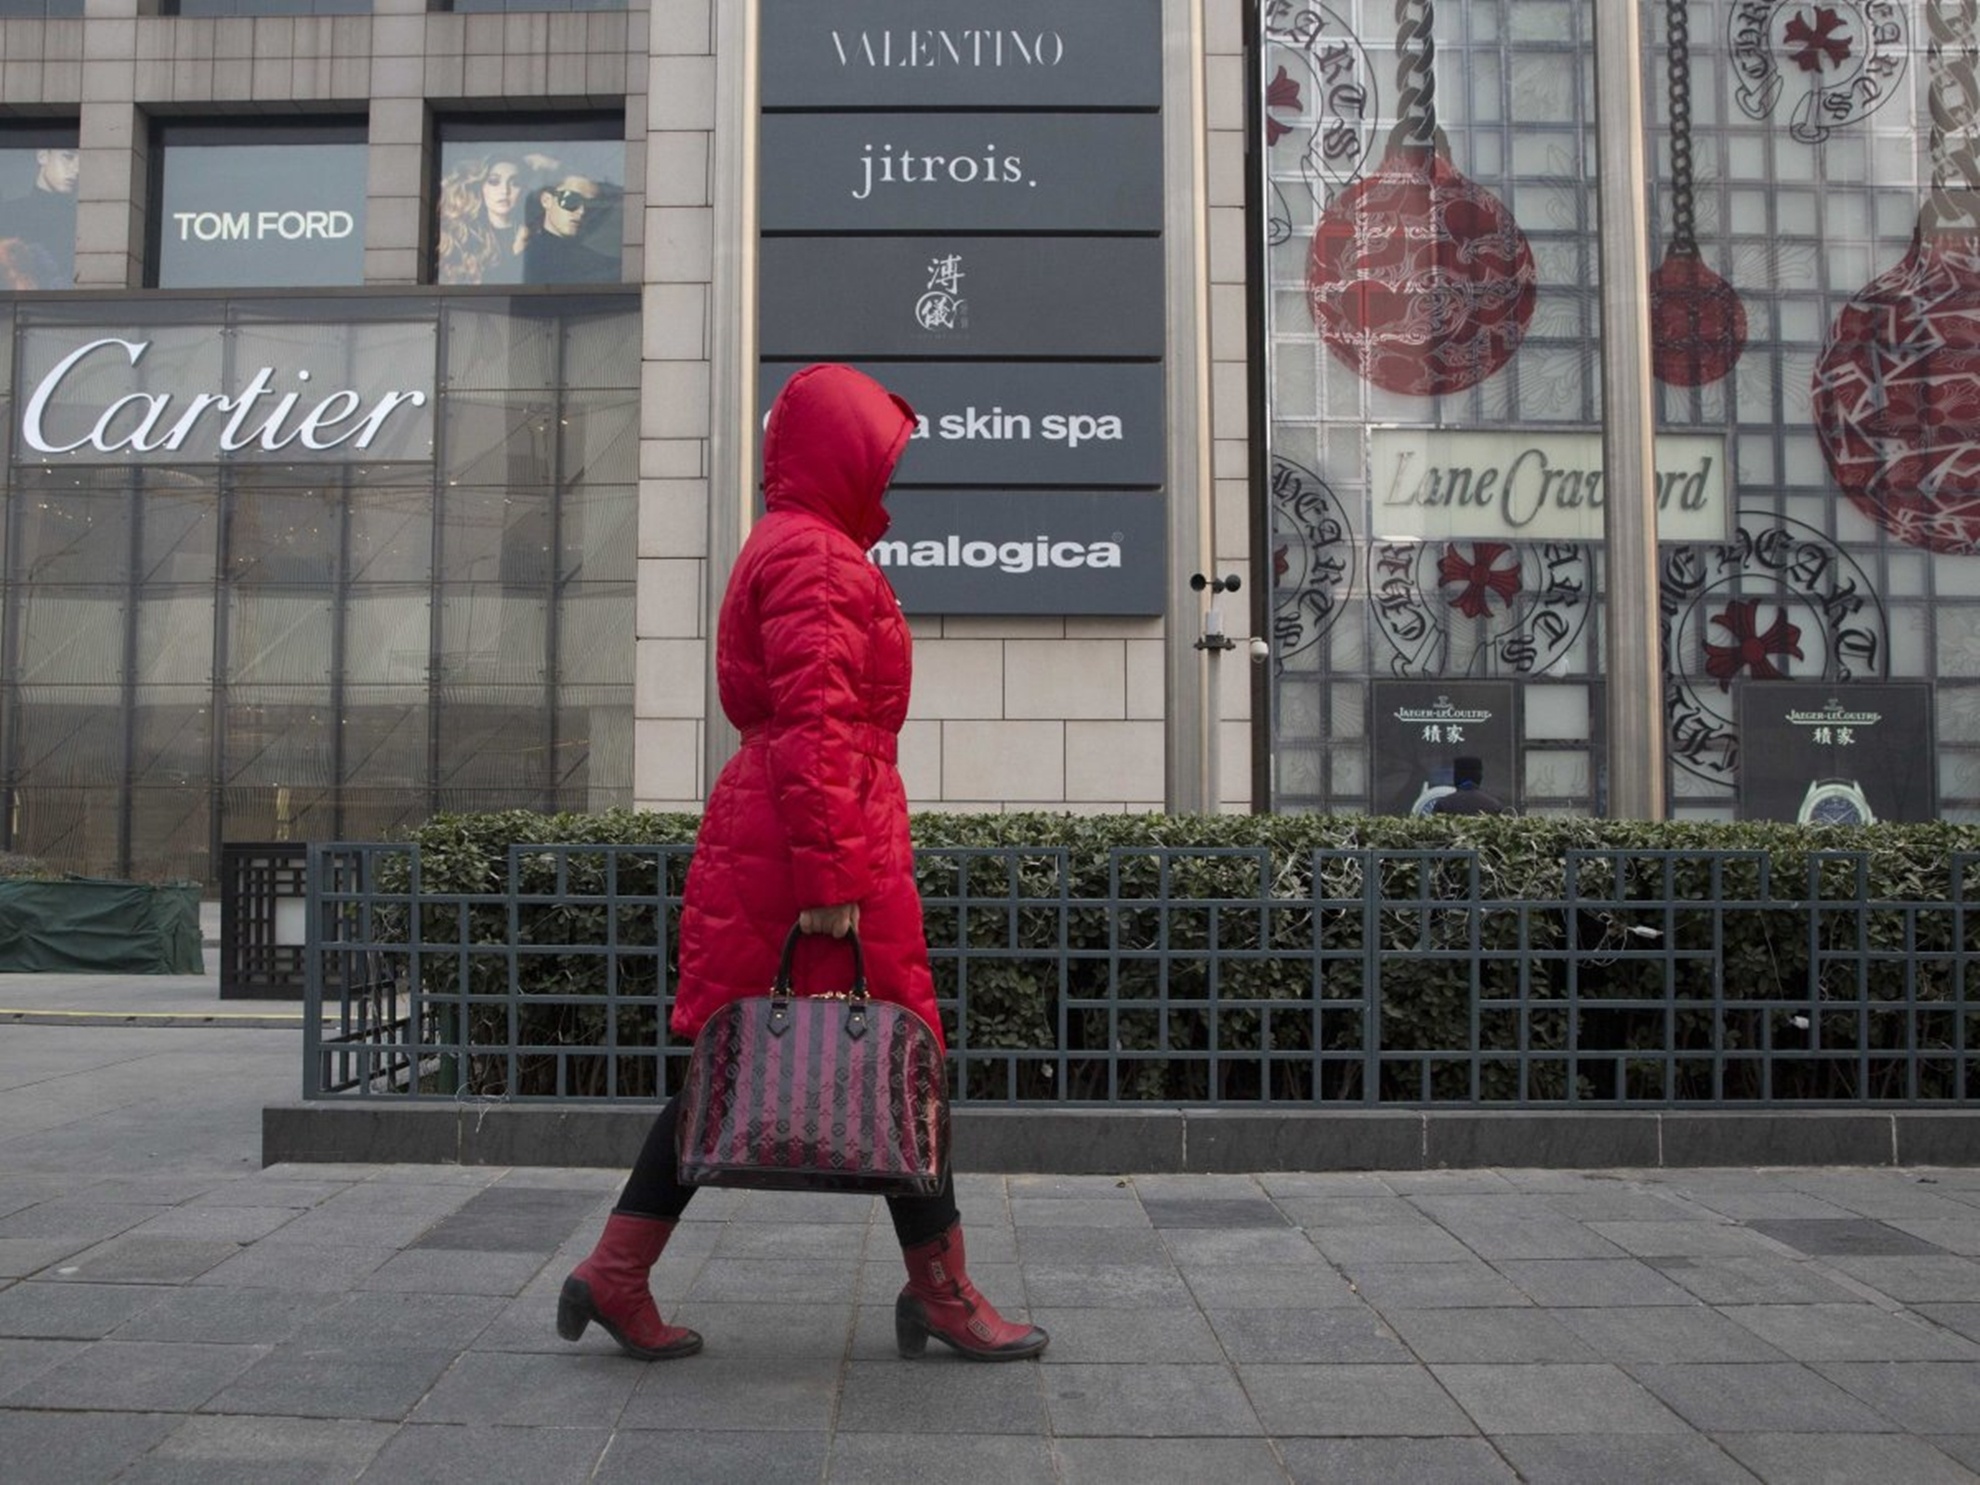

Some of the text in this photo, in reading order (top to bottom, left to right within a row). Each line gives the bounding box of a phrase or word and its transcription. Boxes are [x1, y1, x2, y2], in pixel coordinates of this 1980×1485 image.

[832, 30, 1064, 66] VALENTINO
[852, 144, 1037, 199] jitrois.
[173, 211, 354, 241] TOM FORD
[22, 338, 426, 453] Cartier
[939, 407, 1031, 440] skin
[1041, 415, 1123, 448] spa
[1383, 451, 1498, 507] Lane
[867, 535, 1121, 573] malogica
[1421, 724, 1465, 743] 積家
[1811, 726, 1856, 745] 積家
